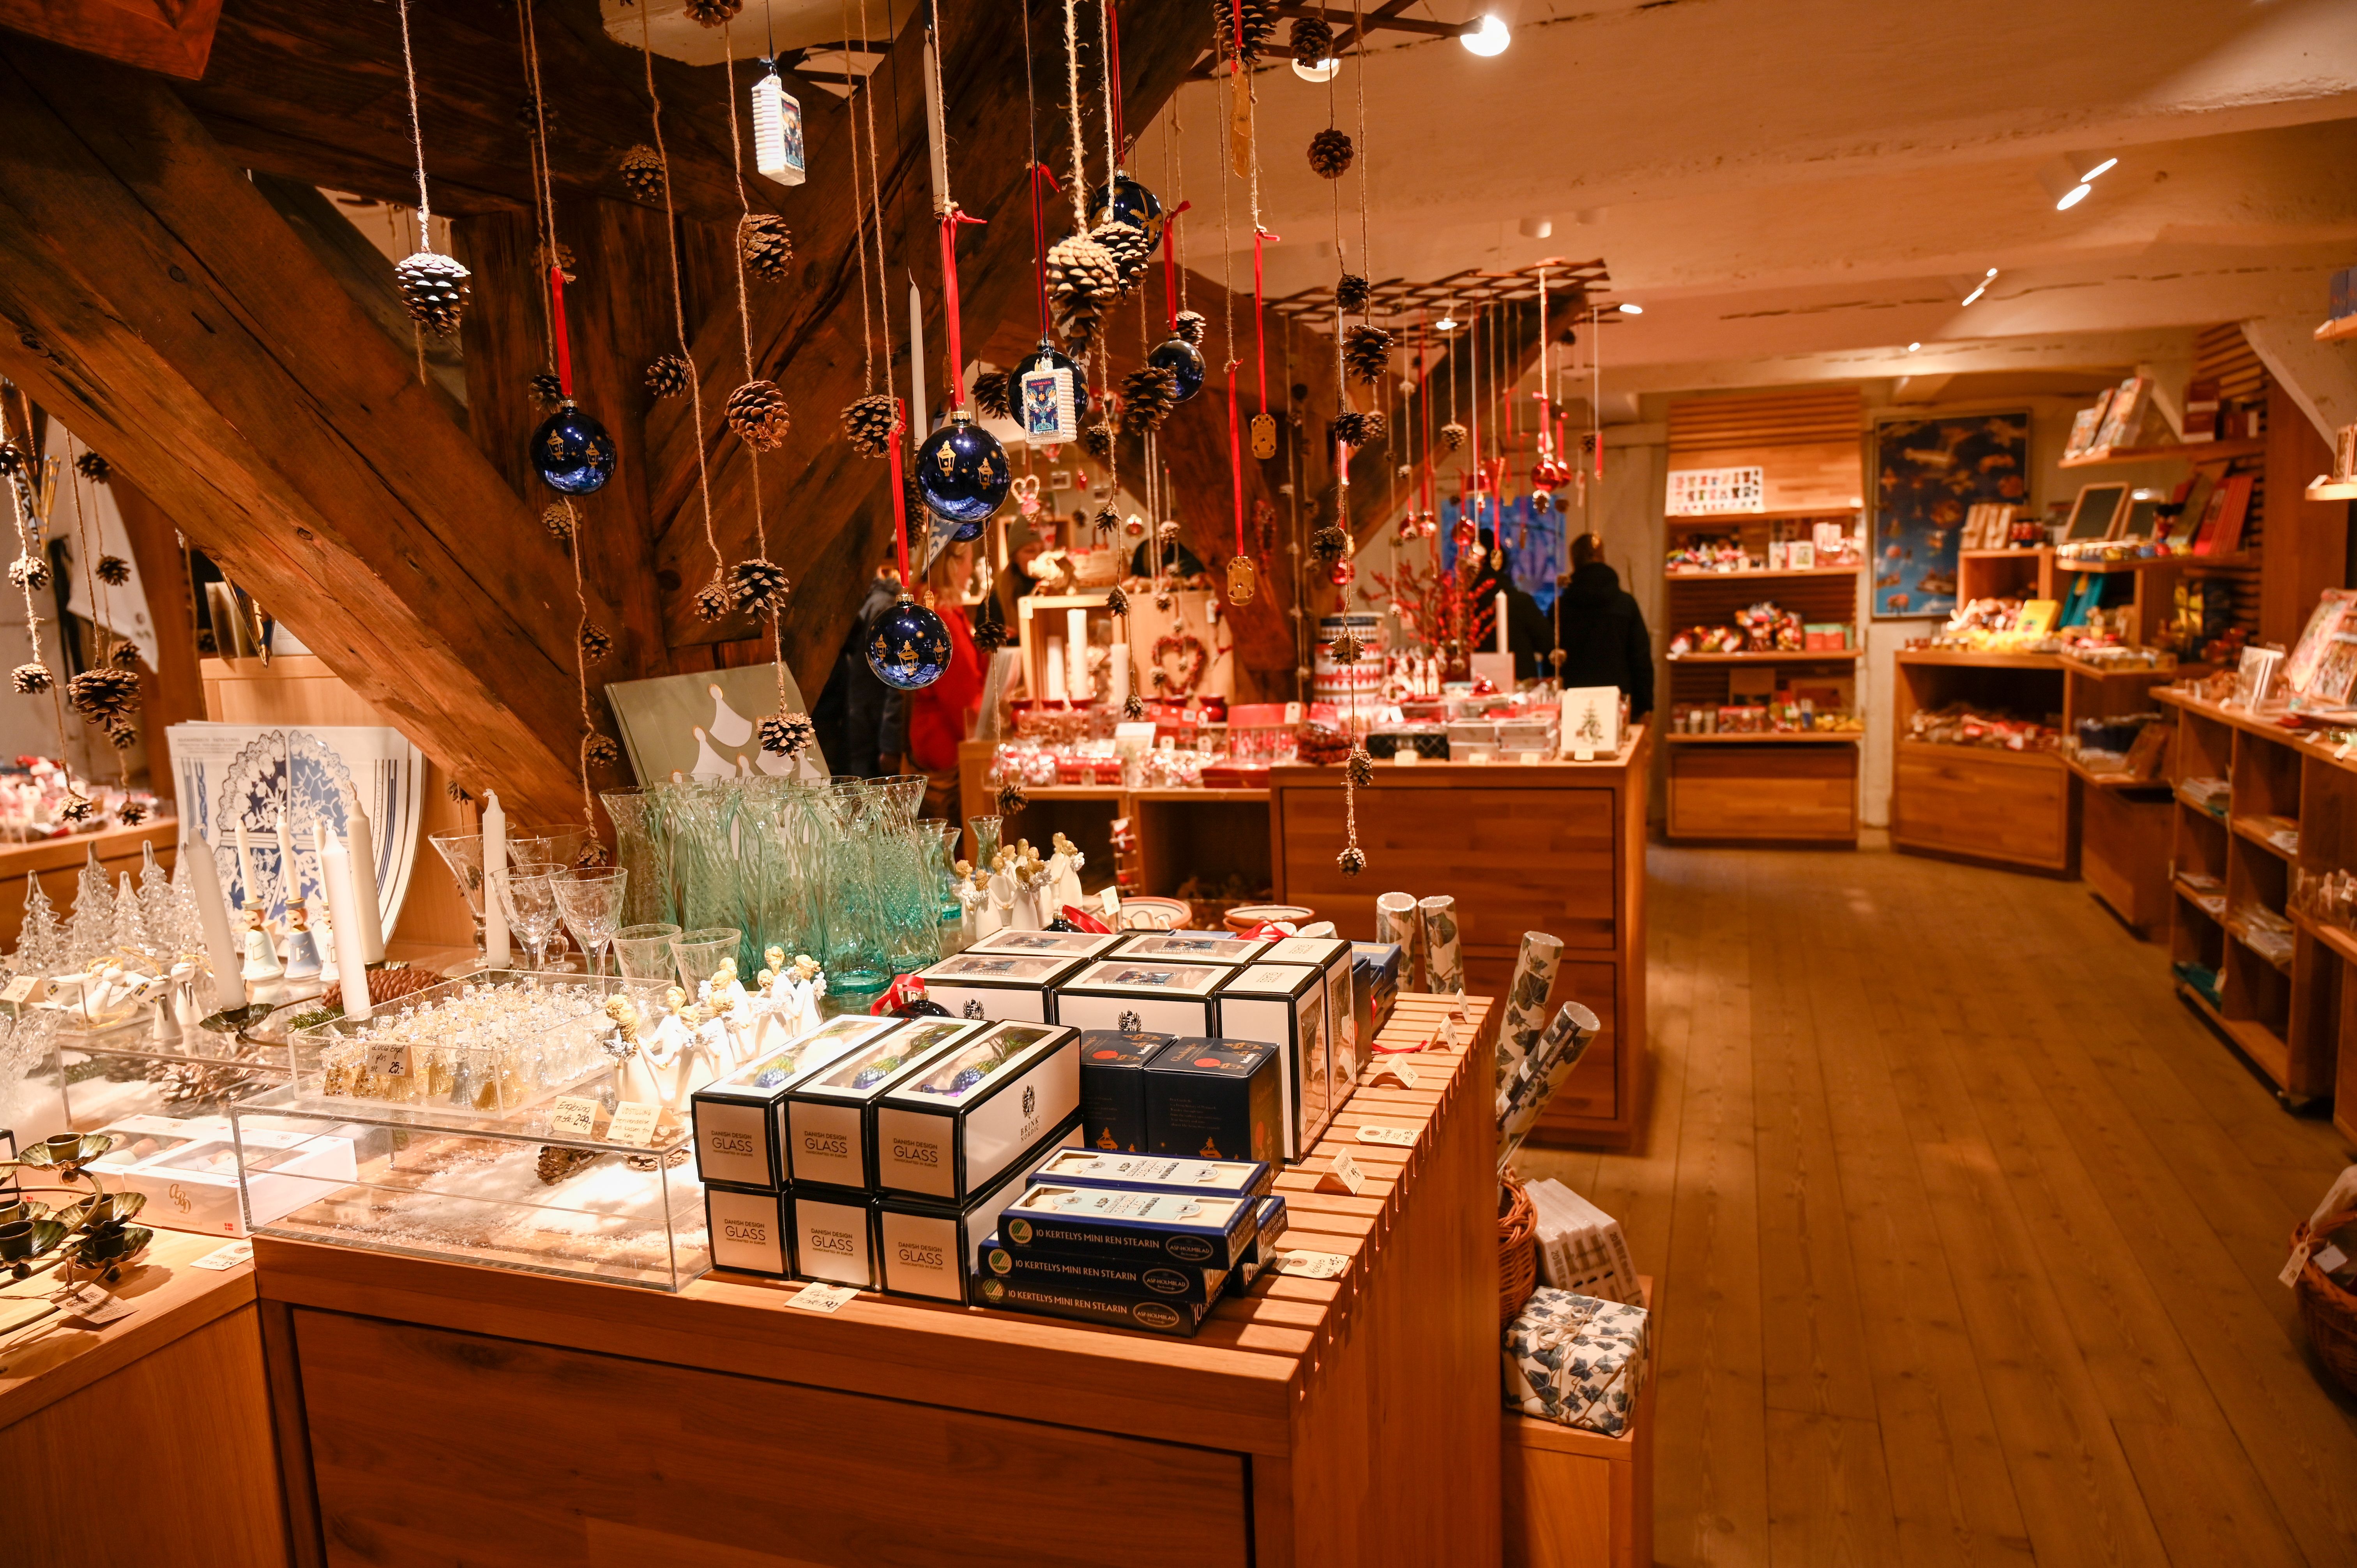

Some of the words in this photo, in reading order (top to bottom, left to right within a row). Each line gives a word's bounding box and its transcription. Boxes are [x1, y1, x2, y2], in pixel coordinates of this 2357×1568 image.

[376, 1053, 387, 1064] glas
[390, 1044, 405, 1059] Engel
[622, 1107, 652, 1116] UDSTILLING
[1021, 1118, 1039, 1136] BRINK
[1021, 1125, 1039, 1143] NORDIC
[804, 1130, 825, 1139] DANISH
[825, 1132, 846, 1141] DESIGN
[712, 1137, 753, 1152] GLASS
[805, 1137, 847, 1153] GLASS
[894, 1138, 915, 1146] DANISH
[916, 1141, 938, 1150] DESIGN
[894, 1145, 938, 1162] GLASS
[724, 1218, 744, 1227] DANISH
[1265, 1212, 1278, 1233] KERTELYS
[726, 1226, 766, 1241] GLASS
[811, 1228, 831, 1236] DANISH
[832, 1231, 853, 1239] DESIGN
[1036, 1229, 1044, 1237] 10
[1046, 1230, 1082, 1241] KERTELYS
[1084, 1234, 1103, 1243] MINI
[1105, 1236, 1122, 1245] REN
[1123, 1236, 1159, 1248] STEARIN
[1257, 1229, 1265, 1252] 10
[1272, 1215, 1285, 1235] STEARIN
[812, 1235, 853, 1252] GLASS
[921, 1244, 942, 1252] DESIGN
[899, 1249, 943, 1266] GLASS
[1551, 1250, 1559, 1260] 20
[1025, 1261, 1060, 1272] KERTELYS
[1062, 1265, 1081, 1274] MINI
[1083, 1266, 1099, 1276] REN
[1101, 1269, 1136, 1281] STEARIN
[1244, 1263, 1253, 1285] 10
[1008, 1290, 1016, 1298] 10
[1017, 1291, 1053, 1303] KERTELYS
[1054, 1296, 1073, 1306] MINI
[1074, 1298, 1091, 1308] REN
[1092, 1301, 1127, 1313] STEARIN
